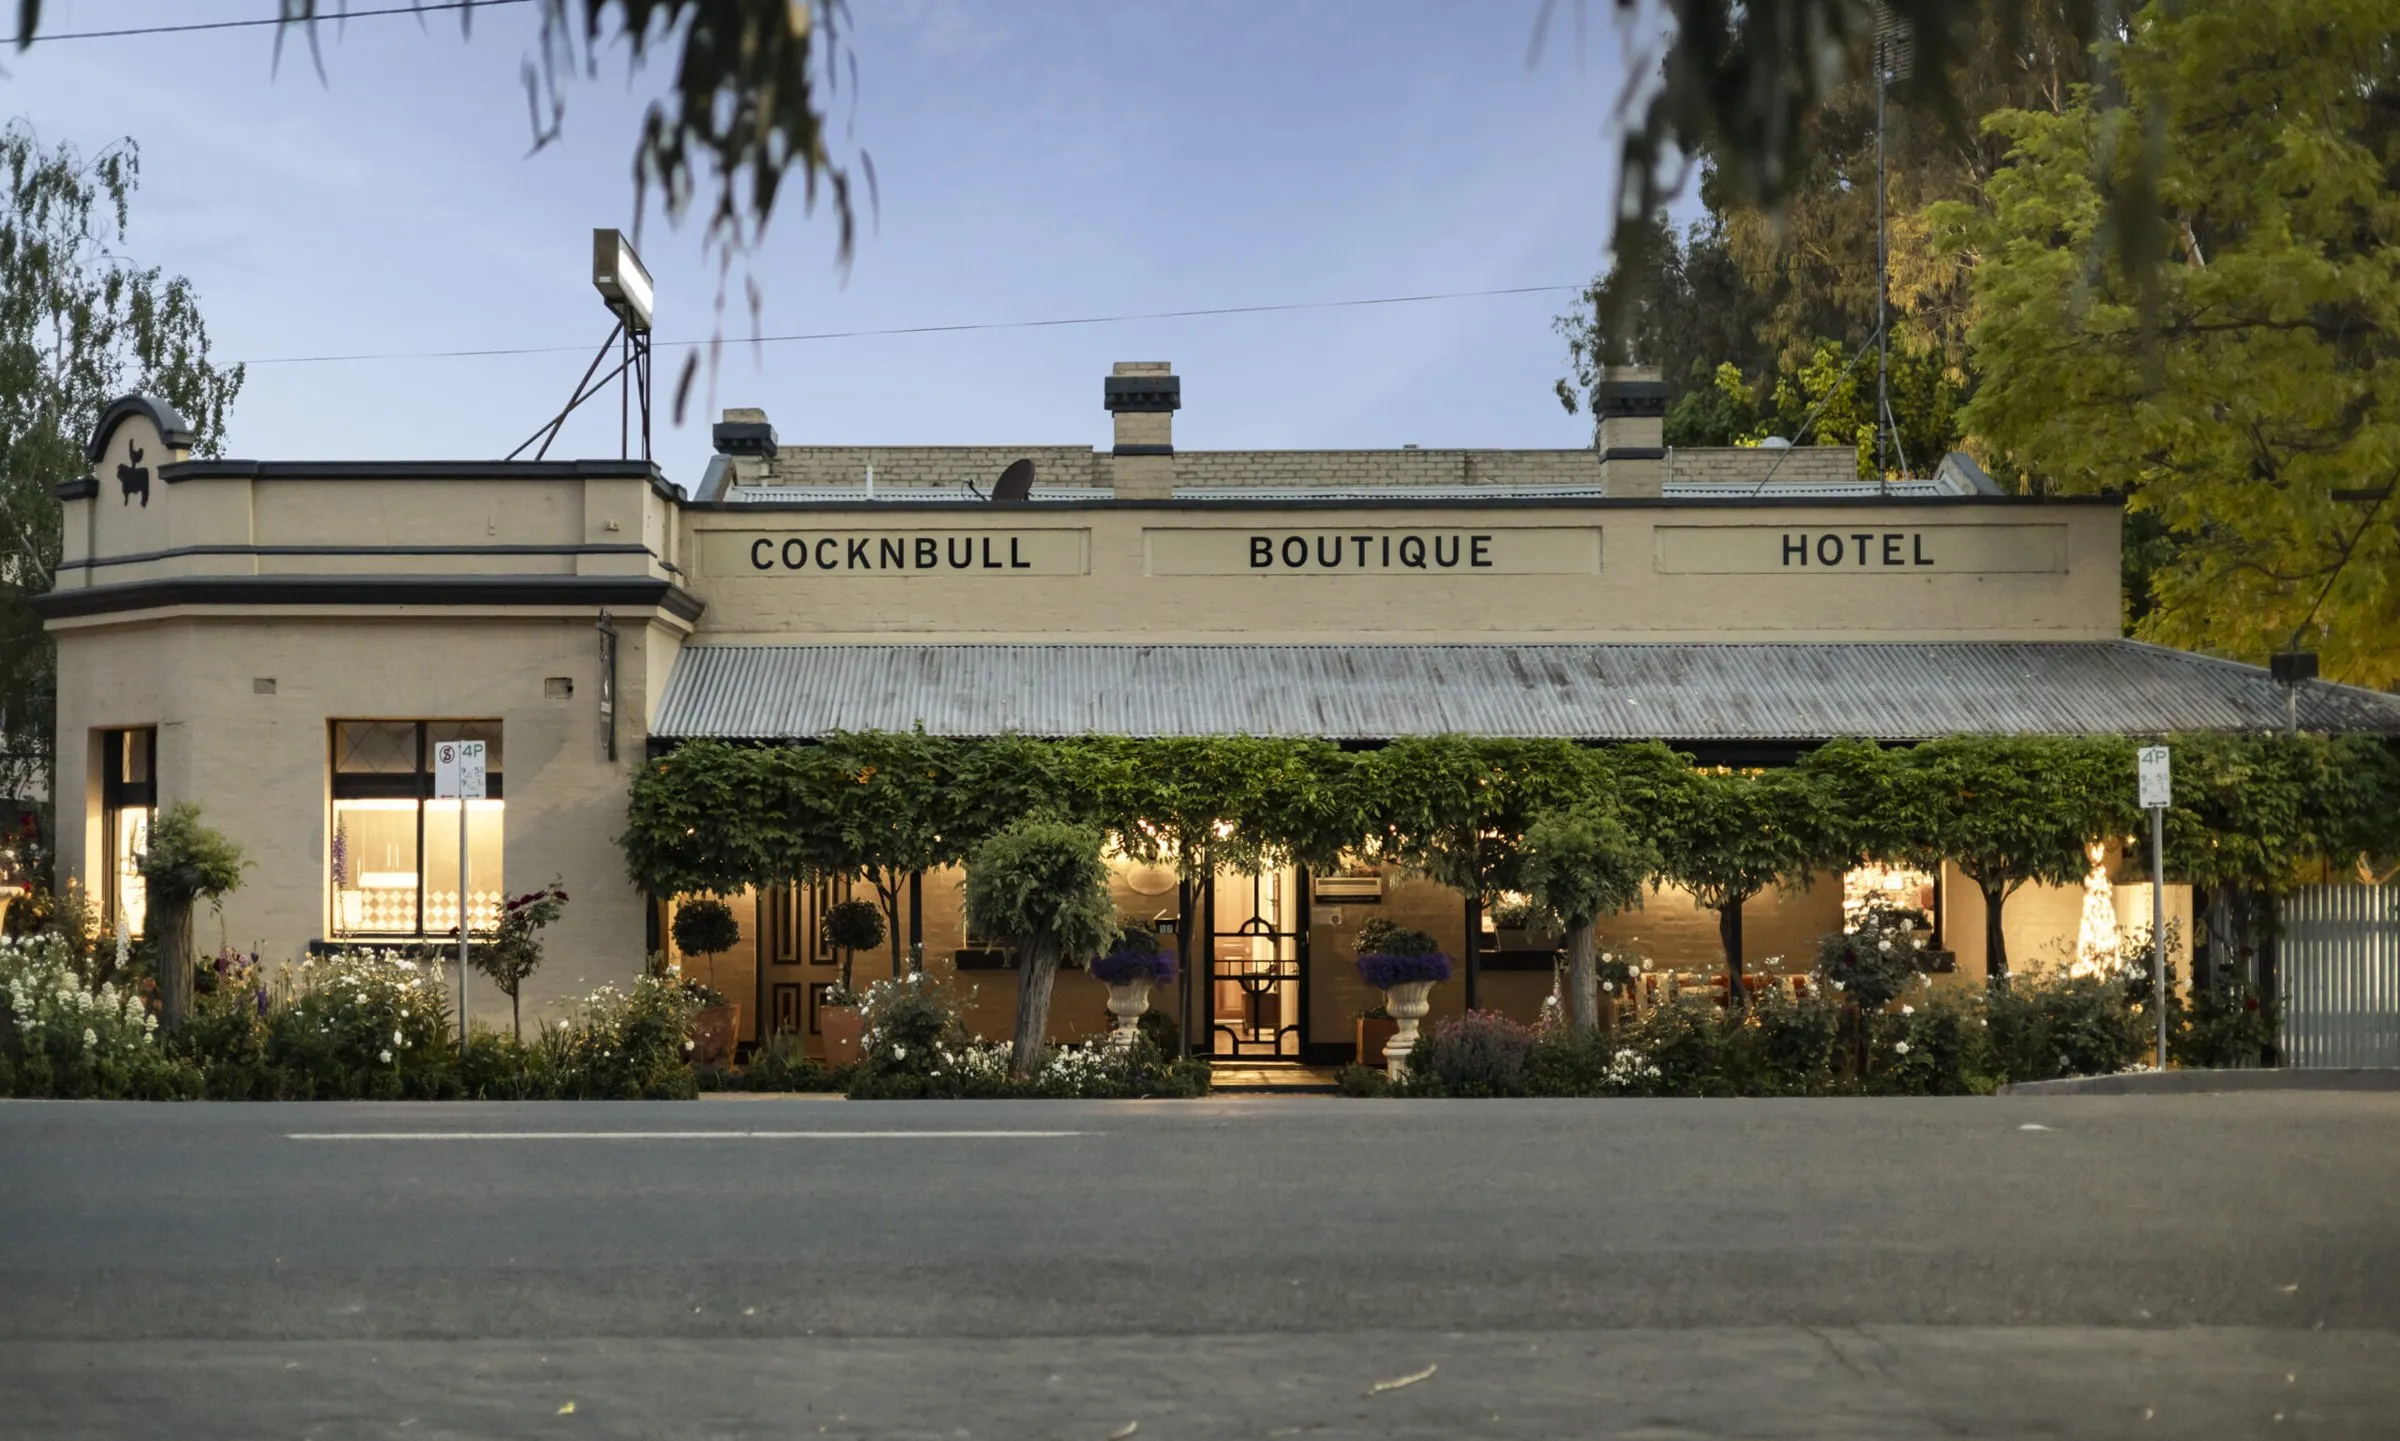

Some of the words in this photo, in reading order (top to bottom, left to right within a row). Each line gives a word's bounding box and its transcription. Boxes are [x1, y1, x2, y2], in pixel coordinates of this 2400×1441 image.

[751, 537, 1031, 570] COCKNBULL
[1250, 536, 1493, 569] BOUTIQUE
[1782, 534, 1935, 566] HOTEL
[462, 744, 484, 758] 4P
[2141, 750, 2168, 765] 4P
